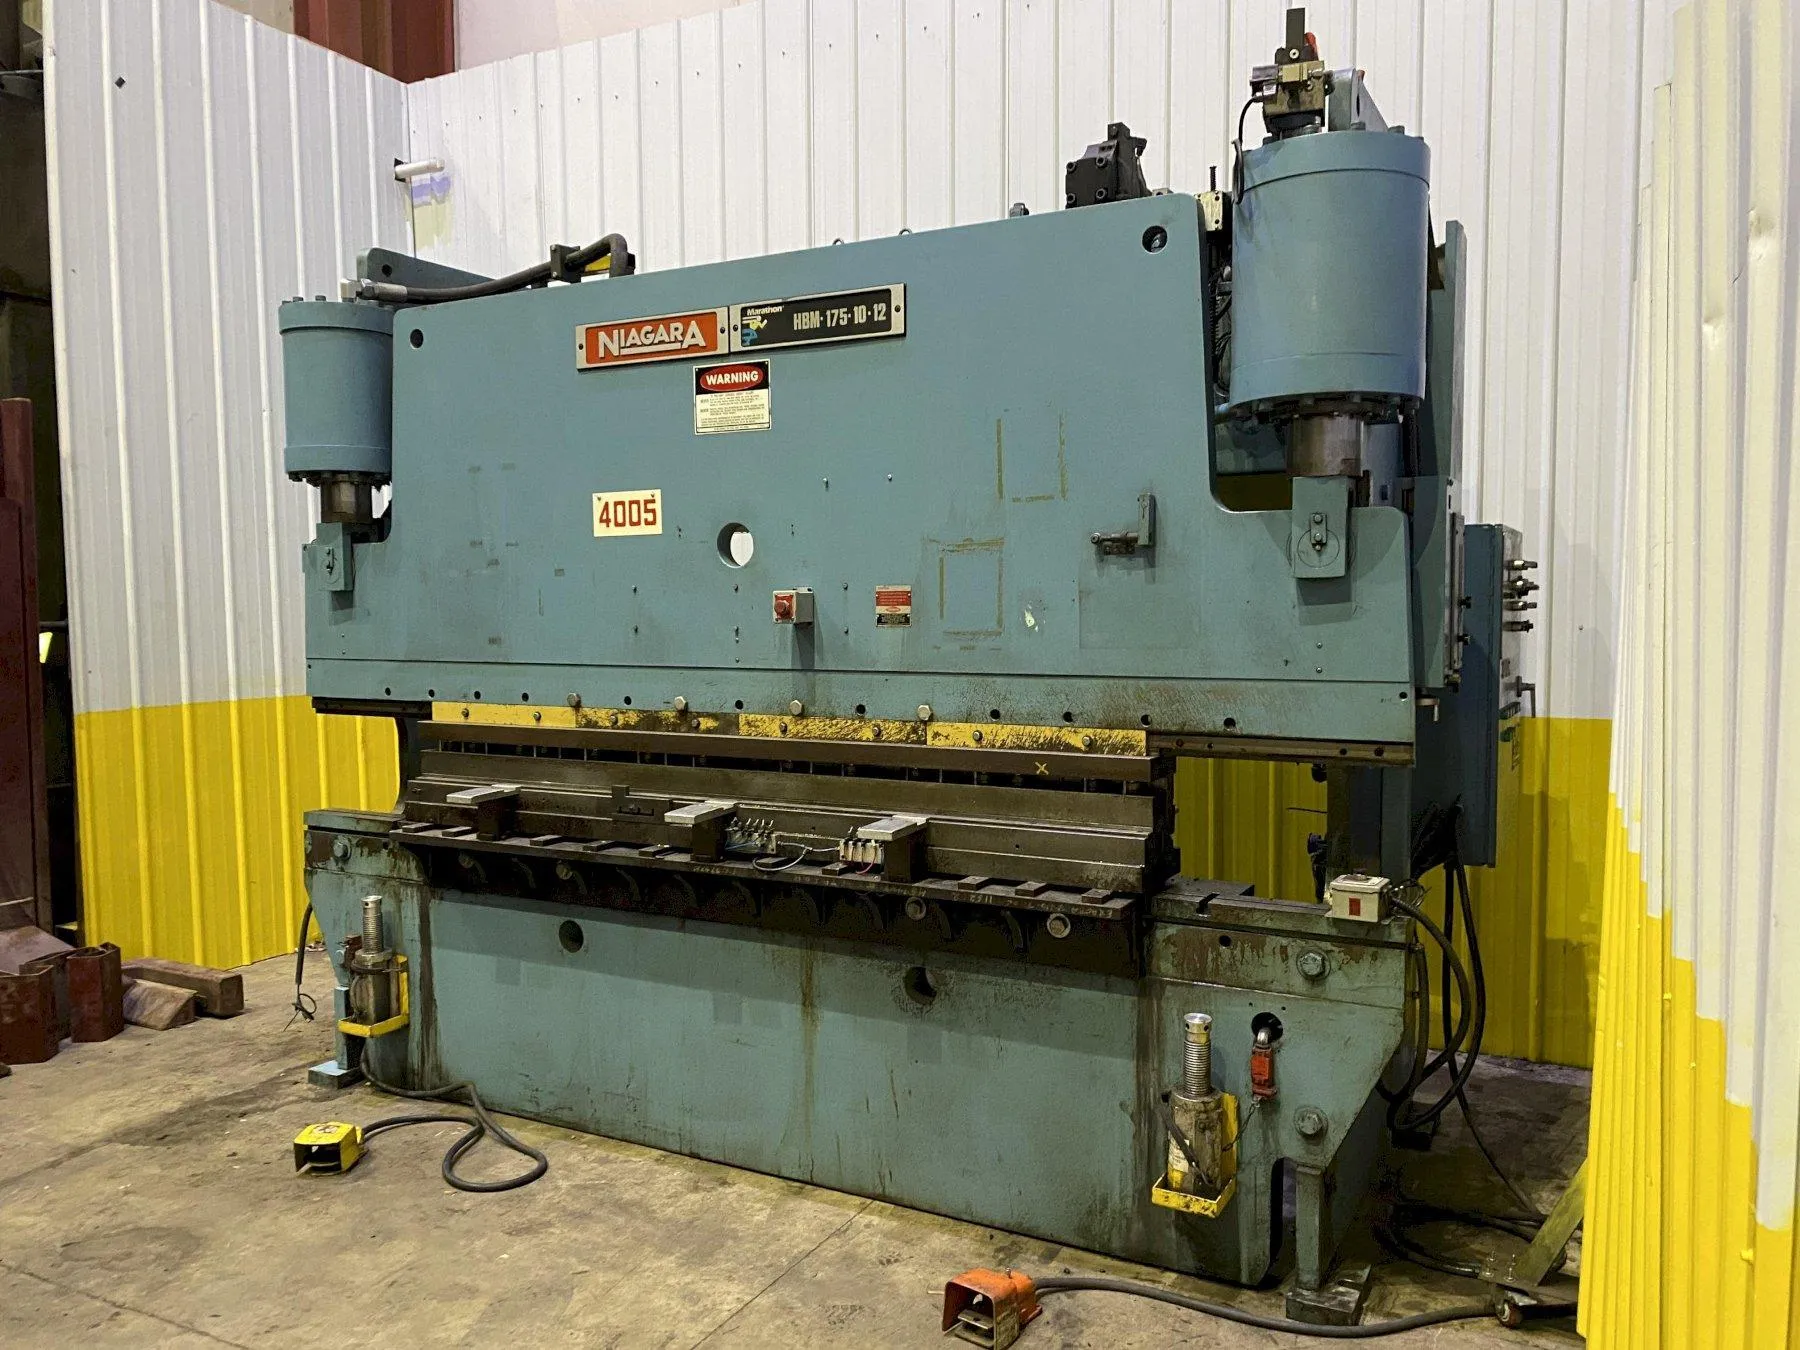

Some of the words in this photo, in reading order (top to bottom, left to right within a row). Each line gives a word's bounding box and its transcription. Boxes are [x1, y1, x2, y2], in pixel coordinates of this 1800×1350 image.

[746, 305, 783, 317] Marathon
[598, 320, 706, 358] NIAGARA
[705, 371, 759, 386] WARNING
[599, 499, 657, 528] 4005
